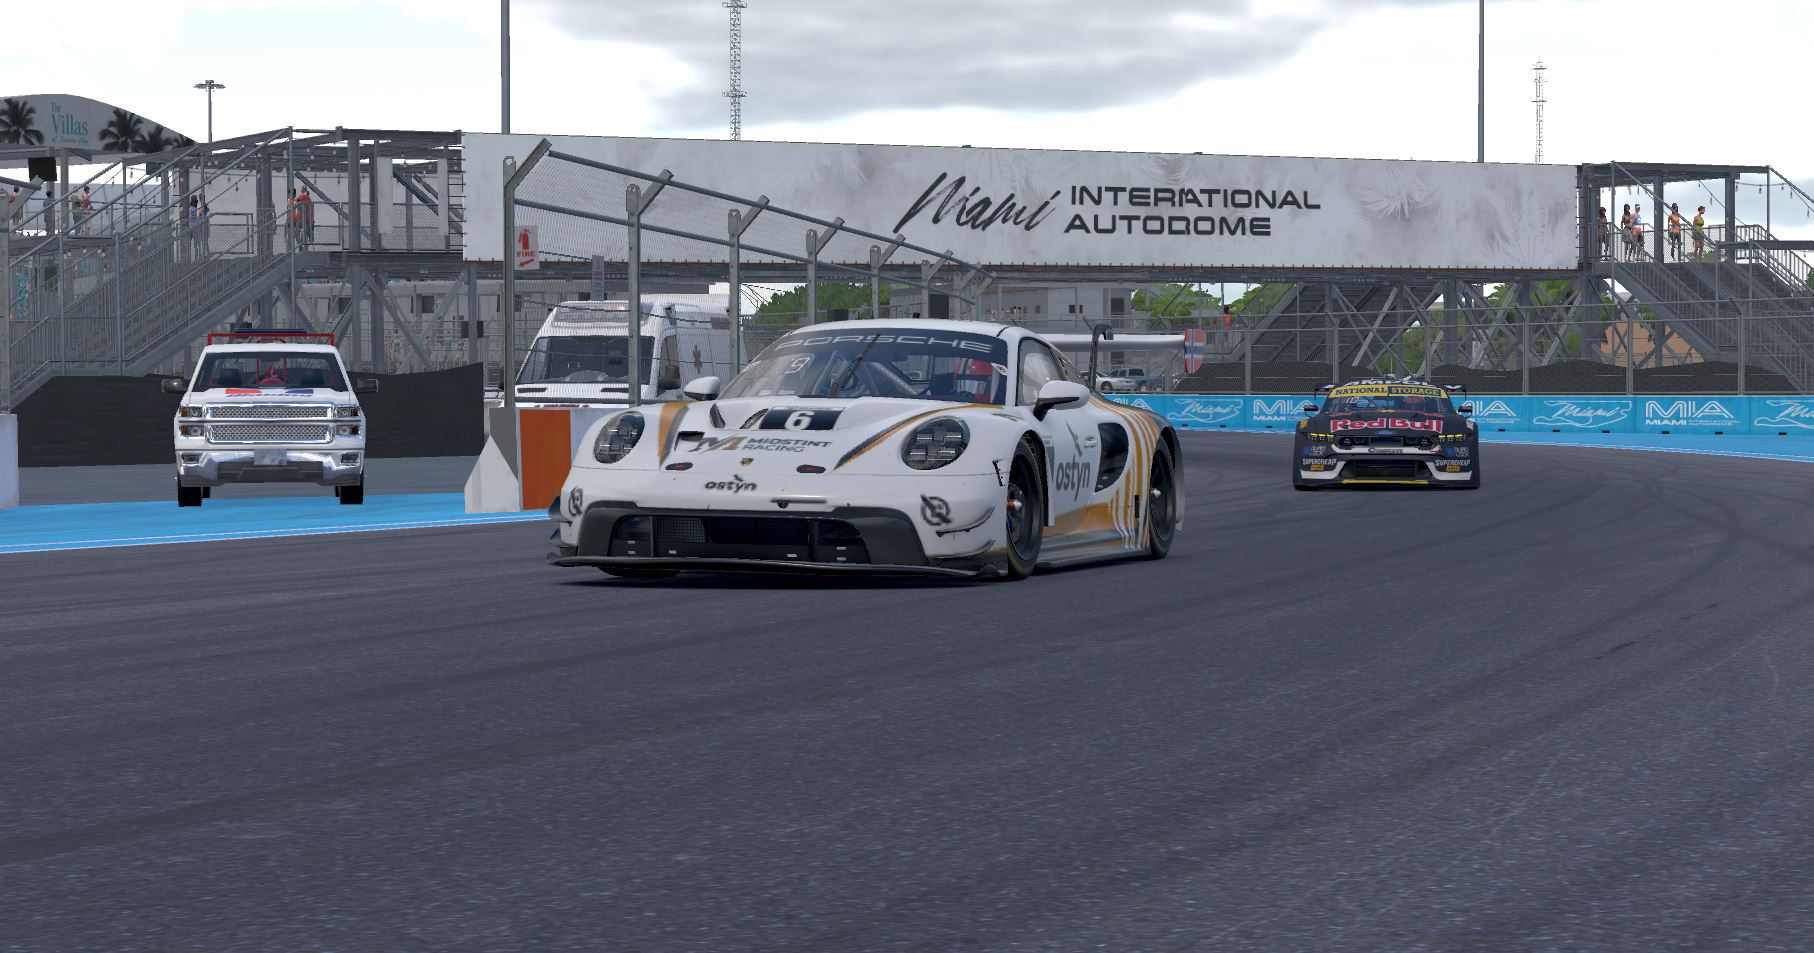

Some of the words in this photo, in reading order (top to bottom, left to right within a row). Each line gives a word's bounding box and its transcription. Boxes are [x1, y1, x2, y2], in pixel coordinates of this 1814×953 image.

[50, 102, 62, 112] The
[51, 113, 88, 136] Villas
[893, 172, 1061, 233] Miami
[774, 335, 993, 353] PORSCHE
[1335, 387, 1387, 395] NATIONAL
[1391, 387, 1440, 396] STORAGE
[1552, 402, 1620, 418] Miami
[1645, 400, 1735, 418] MIA
[784, 410, 816, 430] 6
[1331, 418, 1386, 433] Red
[1389, 418, 1444, 433] Bull
[741, 444, 806, 453] RACING
[746, 438, 833, 448] MIDSTINT
[704, 479, 758, 494] ostyn
[1055, 455, 1091, 502] ostyn
